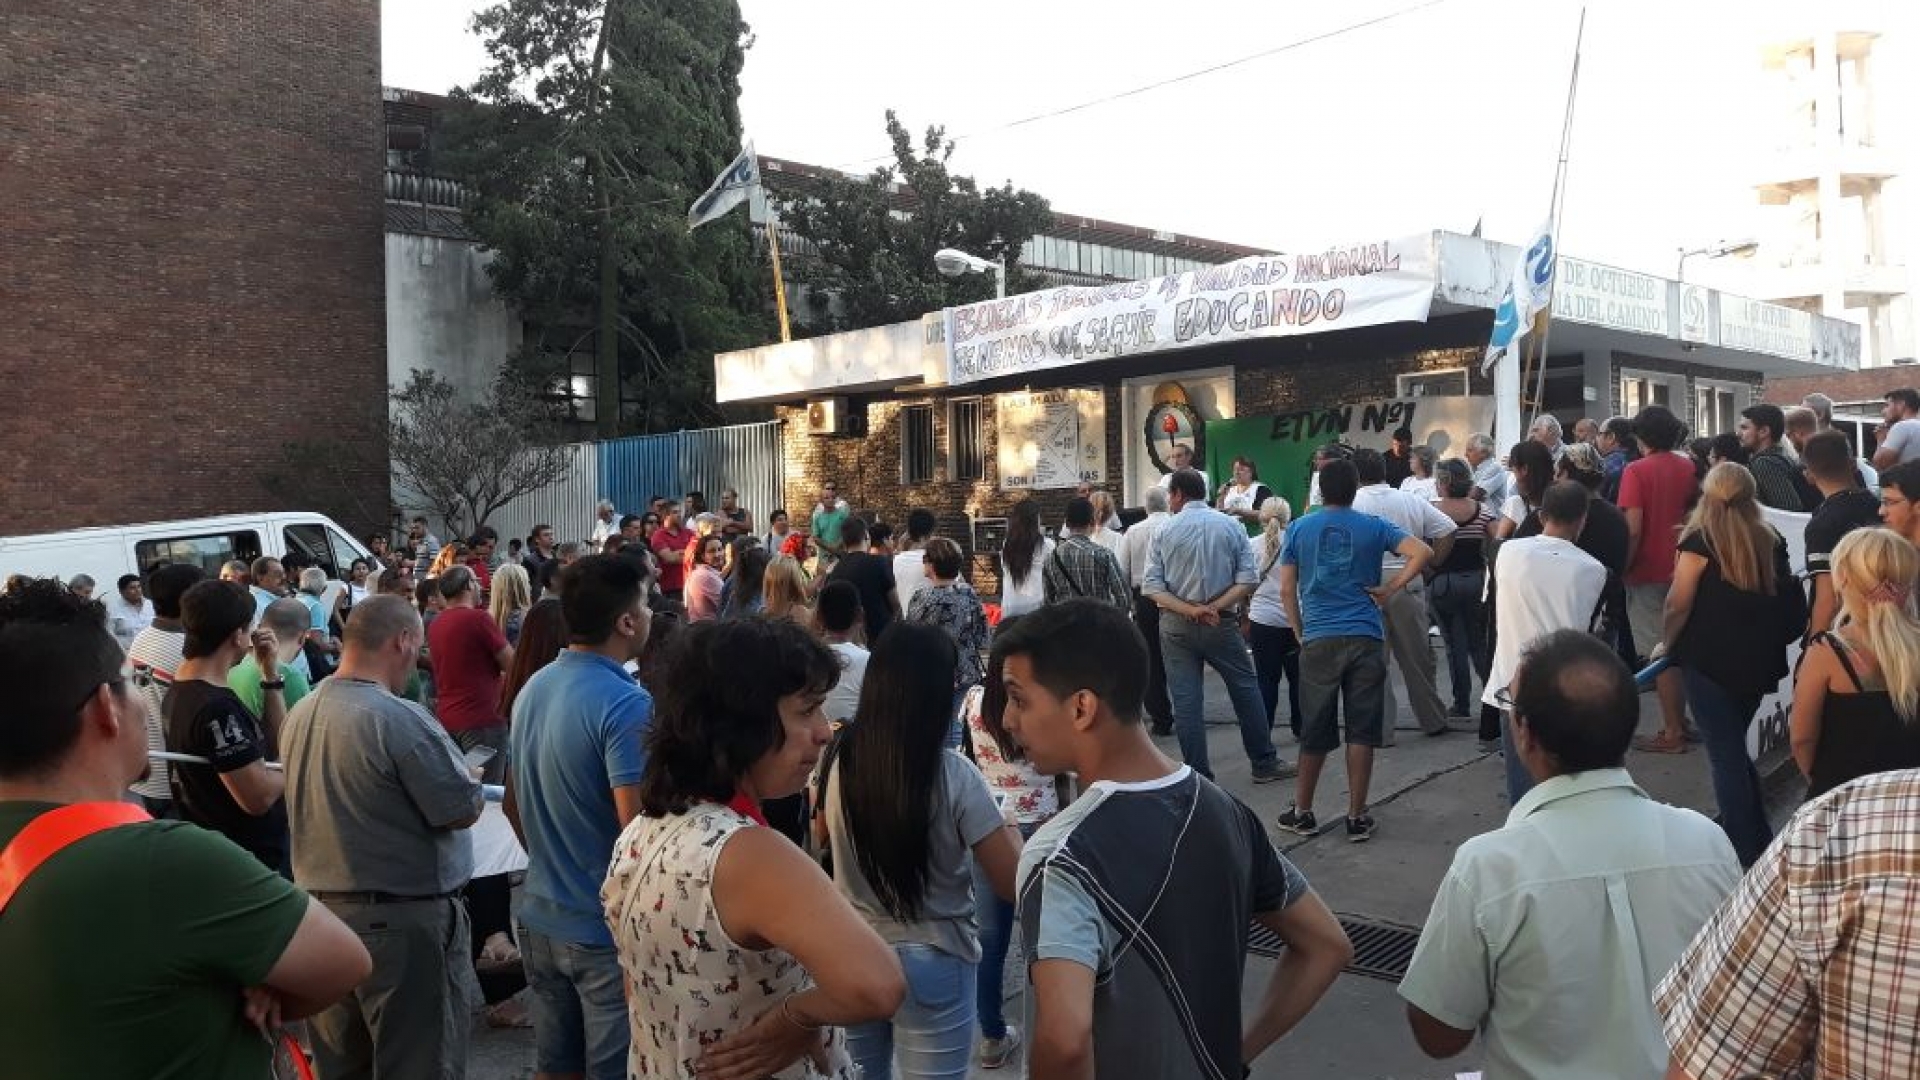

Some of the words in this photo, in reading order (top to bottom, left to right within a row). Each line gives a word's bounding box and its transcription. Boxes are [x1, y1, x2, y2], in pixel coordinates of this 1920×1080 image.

[1591, 267, 1654, 300] OCTUBRE
[954, 293, 1042, 343] ESCUELAS
[1174, 288, 1345, 342] EDUCANDO
[1271, 406, 1351, 441] ETVN
[209, 714, 251, 749] 14
